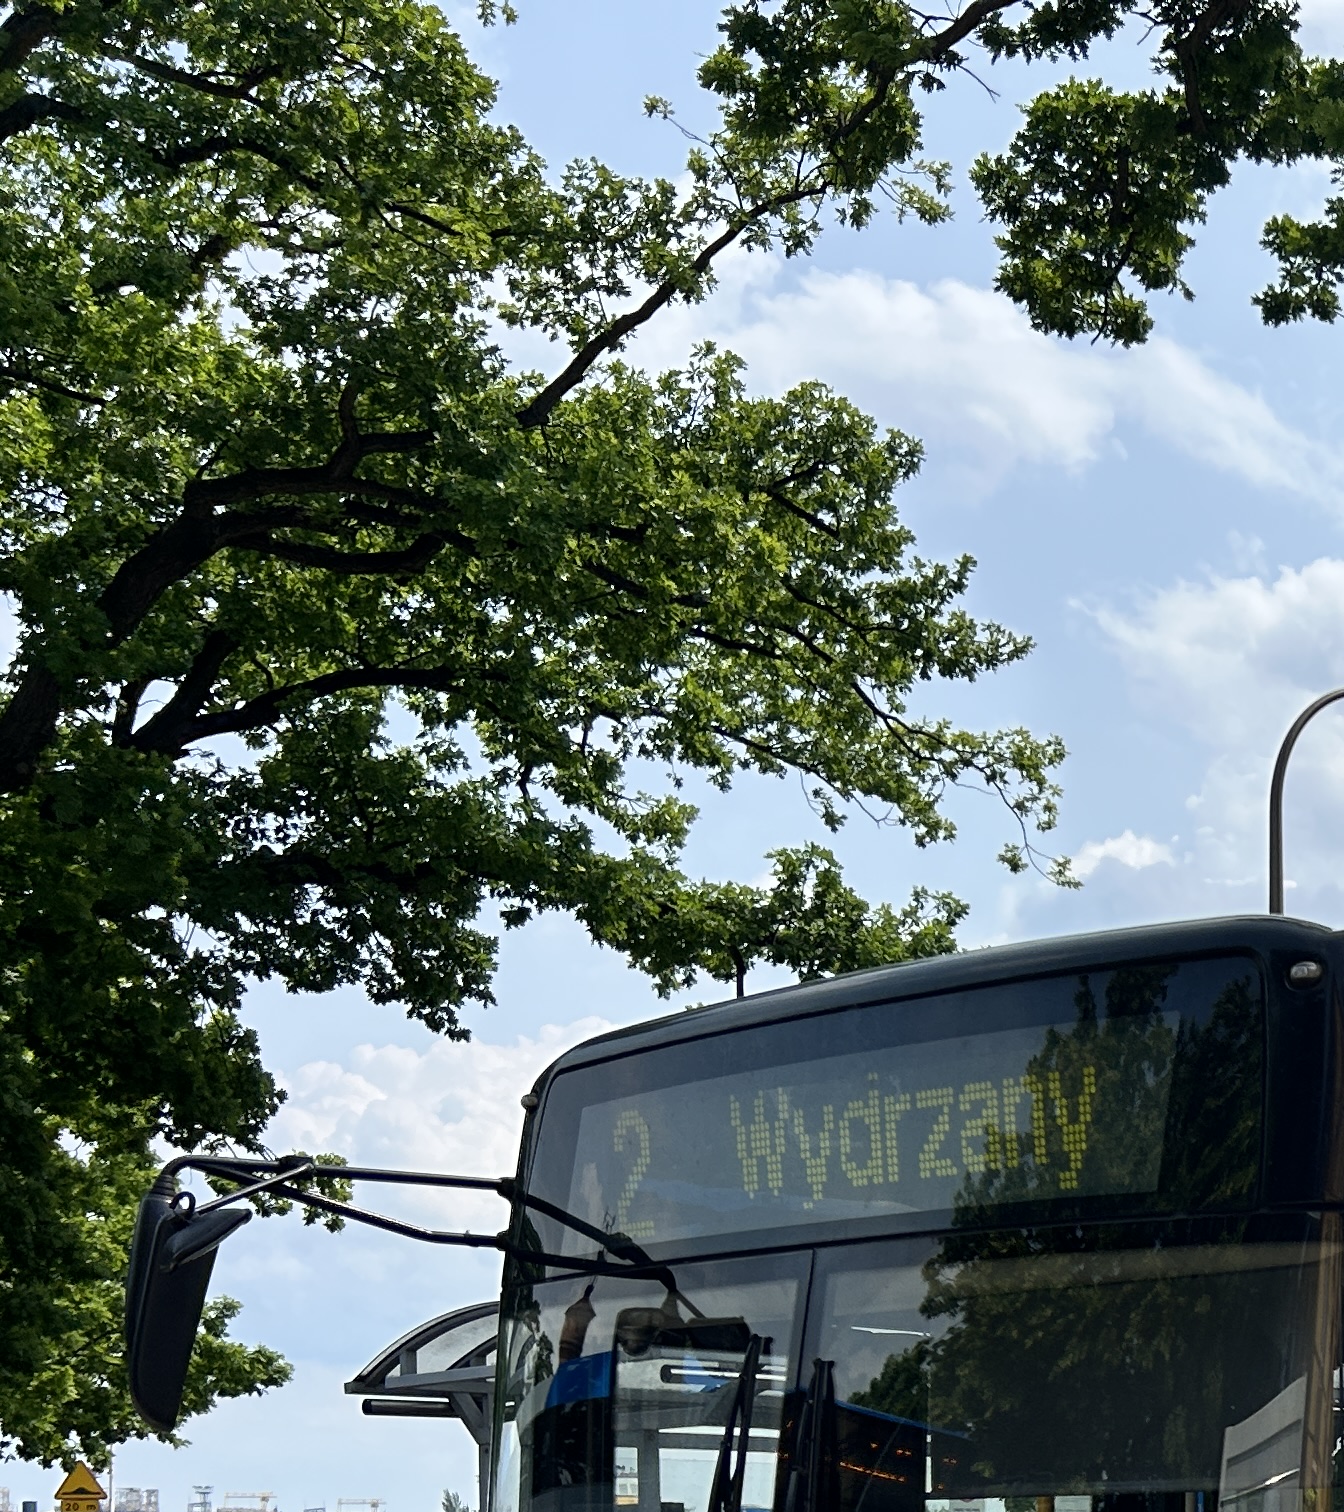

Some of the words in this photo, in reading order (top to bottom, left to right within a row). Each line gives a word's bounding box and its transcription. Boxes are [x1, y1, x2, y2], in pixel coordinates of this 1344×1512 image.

[612, 1108, 655, 1239] 2
[730, 1065, 1097, 1209] Wydrzany
[65, 1503, 79, 1511] 20
